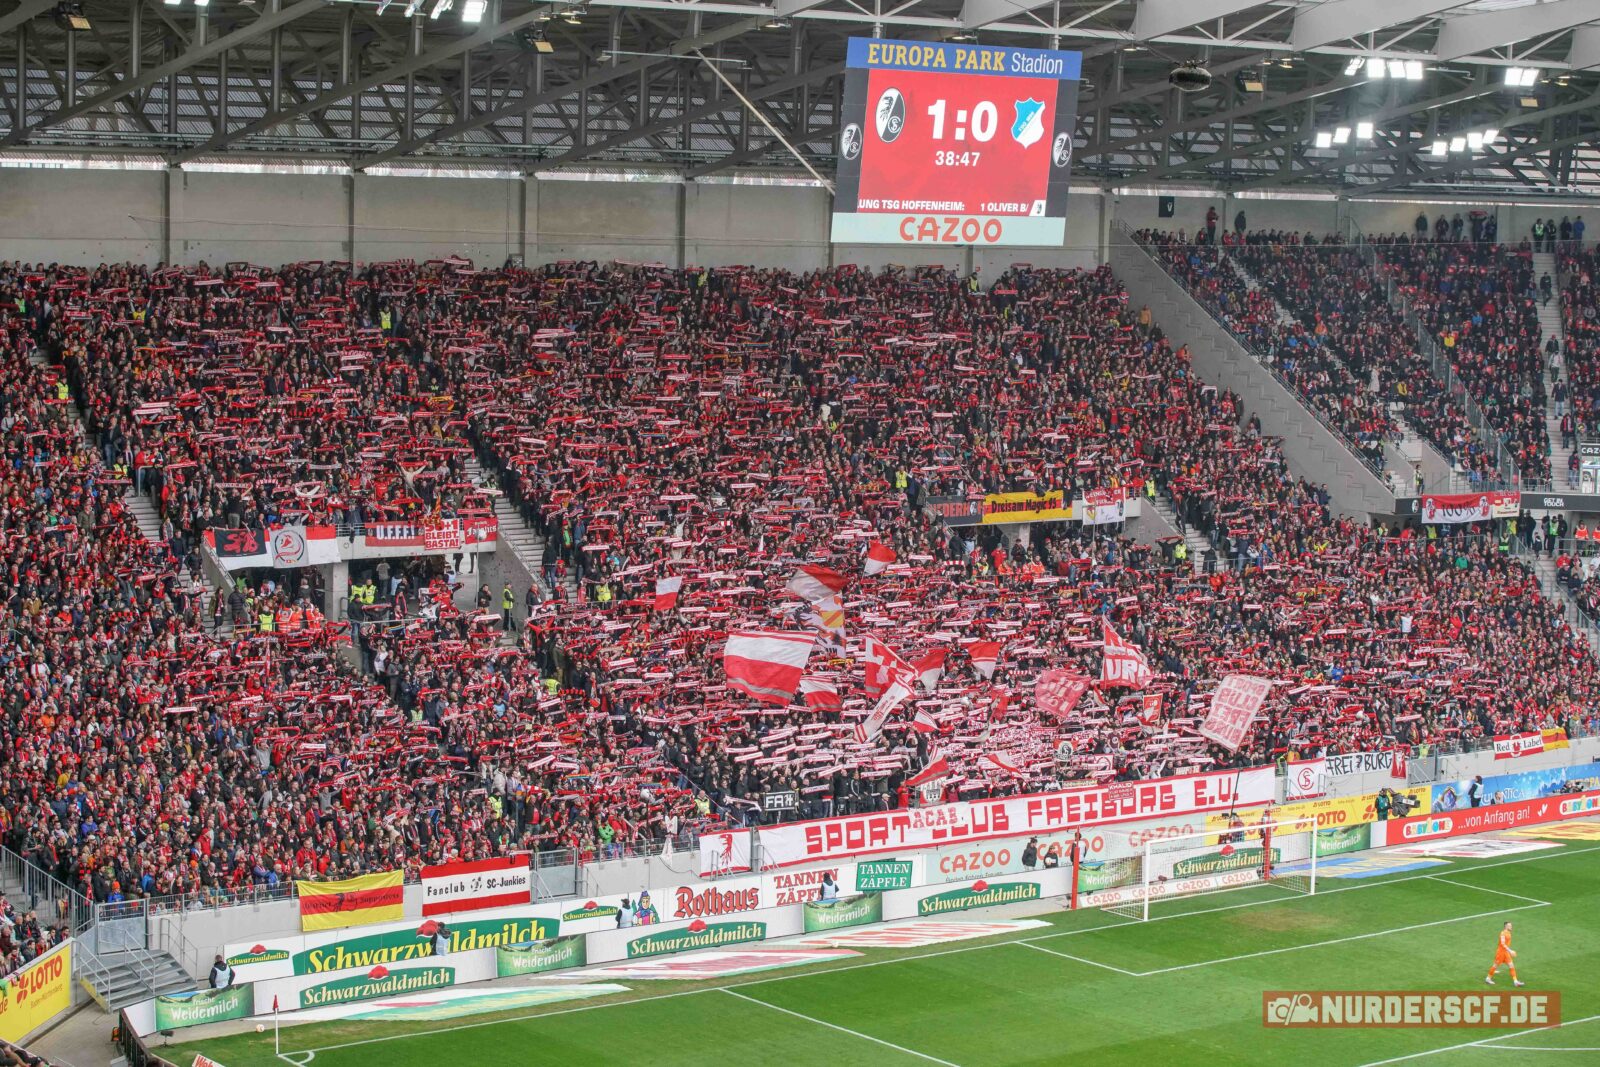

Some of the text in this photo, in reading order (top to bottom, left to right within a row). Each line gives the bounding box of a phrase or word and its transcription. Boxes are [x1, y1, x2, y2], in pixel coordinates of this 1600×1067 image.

[868, 43, 1063, 74] EUROPA PARK Stadion
[927, 99, 998, 142] 1:0
[935, 151, 980, 167] 38:47
[881, 200, 900, 211] TSG
[901, 200, 965, 212] HOFFENHEIM:
[980, 203, 985, 213] 1
[987, 203, 1019, 213] OLIVER
[899, 216, 1003, 243] CAZOO
[991, 500, 1024, 513] Dreisam
[1026, 498, 1046, 513] Magic
[425, 538, 460, 548] BASTA!
[1496, 737, 1542, 753] Red Label
[1364, 751, 1393, 772] BURG
[1484, 809, 1515, 825] Anfang
[1516, 806, 1530, 821] an!
[805, 815, 912, 855] SPORT
[859, 863, 911, 875] TANNEN
[940, 848, 1011, 874] CAZOO
[426, 875, 527, 897] Fanclub SC-Junkies
[860, 875, 908, 889] ZÄPFLE
[1176, 879, 1211, 892] CAZOO
[673, 886, 760, 919] Rothaus
[921, 884, 1037, 914] Schwarzwaldmilch
[1086, 892, 1122, 906] CAZOO
[562, 906, 619, 921] Schwarzwaldmilch
[307, 920, 546, 974] Schwarzwldmilch
[630, 922, 763, 957] Schwarzwaldmilch
[226, 950, 290, 967] Schwarzwaldmilch
[512, 947, 572, 969] Weidemilch
[30, 954, 63, 994] LOTTO
[303, 967, 451, 1006] Schwarzwaldmilch
[171, 996, 239, 1021] Weidemilch
